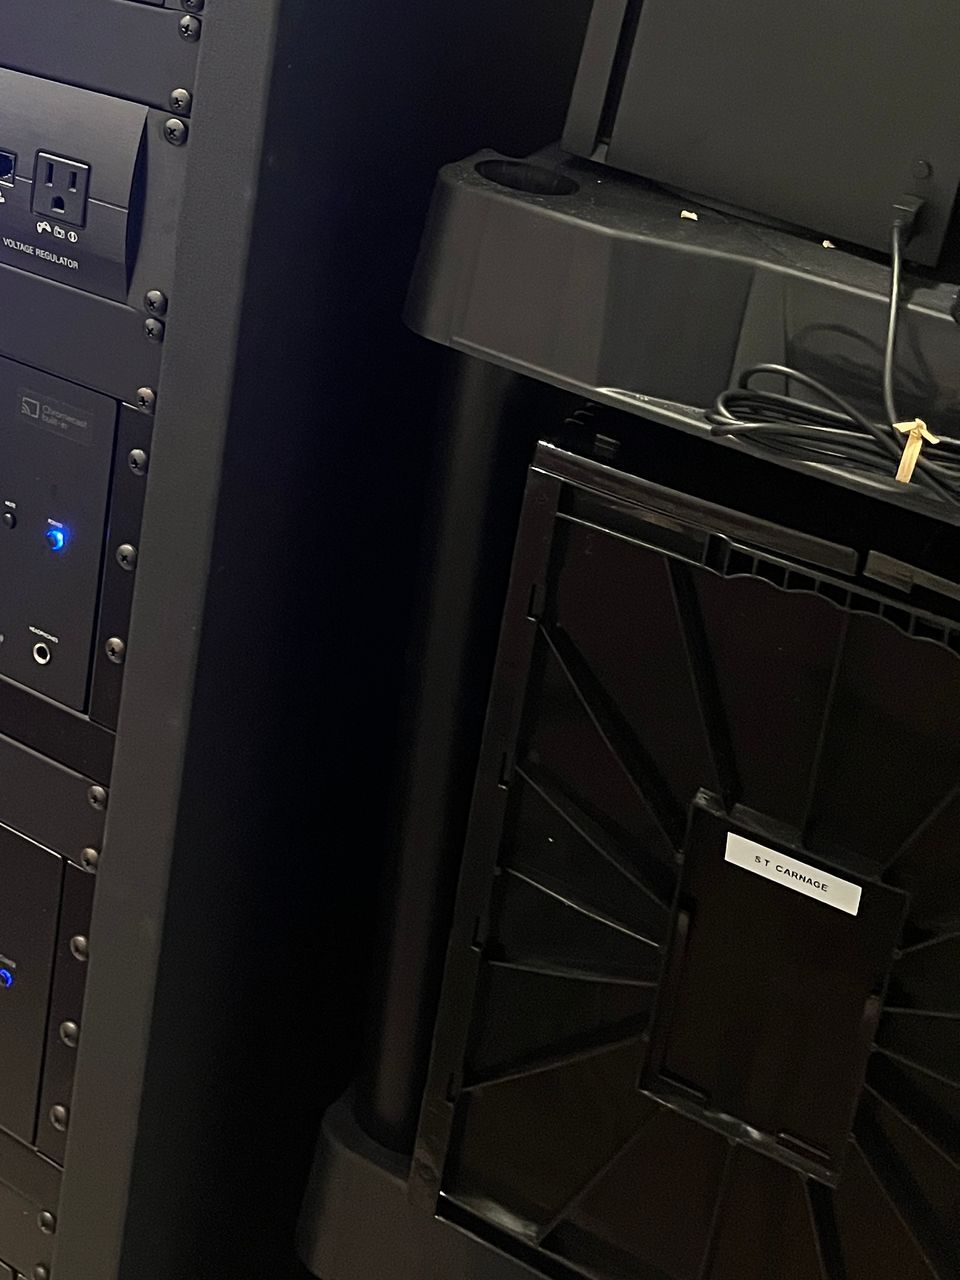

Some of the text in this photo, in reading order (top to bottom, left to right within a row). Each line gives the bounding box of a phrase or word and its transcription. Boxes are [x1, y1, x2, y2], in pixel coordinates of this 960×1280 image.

[3, 237, 35, 255] VOLTAGE
[35, 248, 79, 270] REGULATOR
[775, 864, 829, 893] CARNAGE
